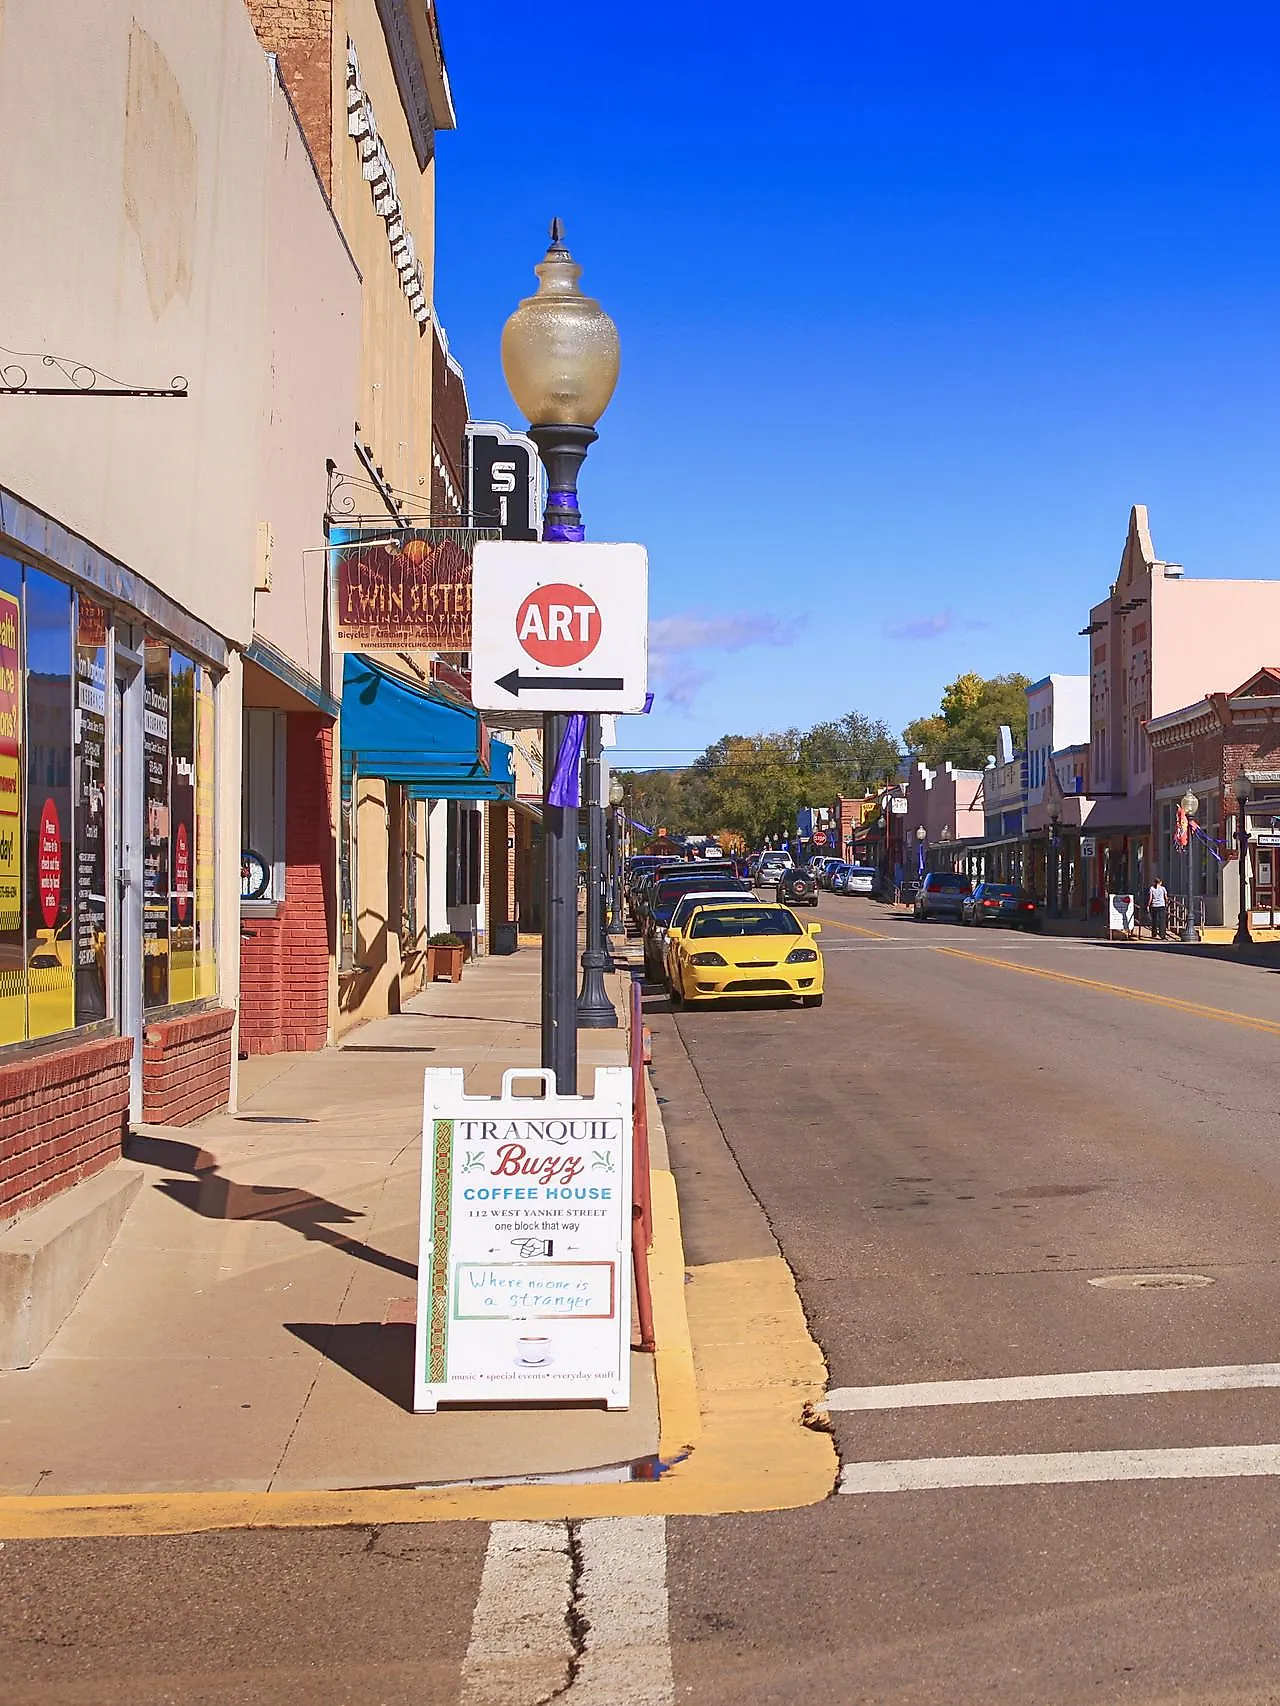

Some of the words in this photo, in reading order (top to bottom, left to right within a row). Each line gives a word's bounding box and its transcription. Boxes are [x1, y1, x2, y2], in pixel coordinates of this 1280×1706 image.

[347, 583, 403, 612] TWIN
[404, 613, 433, 623] AND
[518, 604, 596, 641] ART
[338, 631, 368, 639] Bicycles
[460, 1121, 618, 1145] TRANQUIL
[490, 1143, 585, 1185] Buzz
[463, 1188, 539, 1200] COFFEE
[546, 1188, 612, 1200] HOUSE
[490, 1209, 521, 1217] WEST
[523, 1209, 564, 1217] YANKIE
[566, 1209, 608, 1217] STREET
[494, 1222, 512, 1231] one
[514, 1220, 539, 1231] block
[541, 1220, 559, 1231] that
[561, 1222, 580, 1233] way
[469, 1271, 521, 1288] Where
[576, 1279, 588, 1291] is
[484, 1296, 497, 1306] a
[509, 1292, 593, 1312] stranger
[451, 1372, 477, 1381] music
[486, 1371, 516, 1382] special
[552, 1371, 592, 1382] everyday
[594, 1370, 615, 1380] stuff
